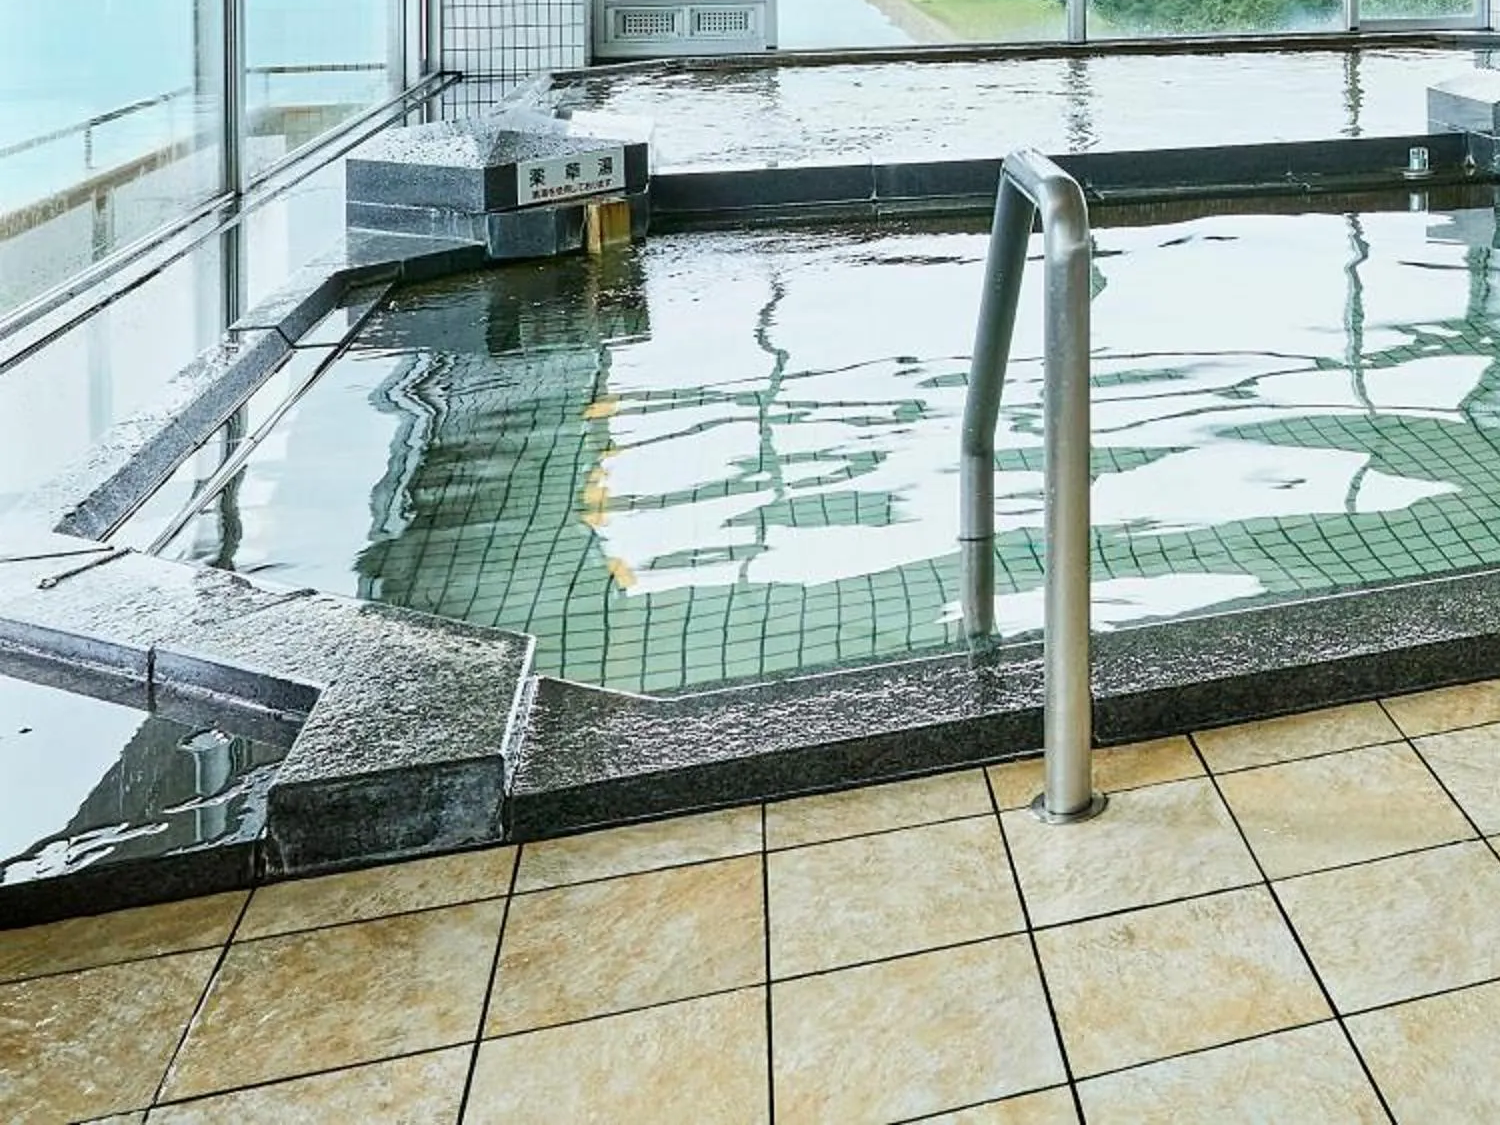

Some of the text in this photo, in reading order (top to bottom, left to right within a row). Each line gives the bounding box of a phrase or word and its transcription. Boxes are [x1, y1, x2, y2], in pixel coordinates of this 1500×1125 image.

[529, 156, 613, 187] 薬草湯
[531, 178, 612, 199] を使用しております
